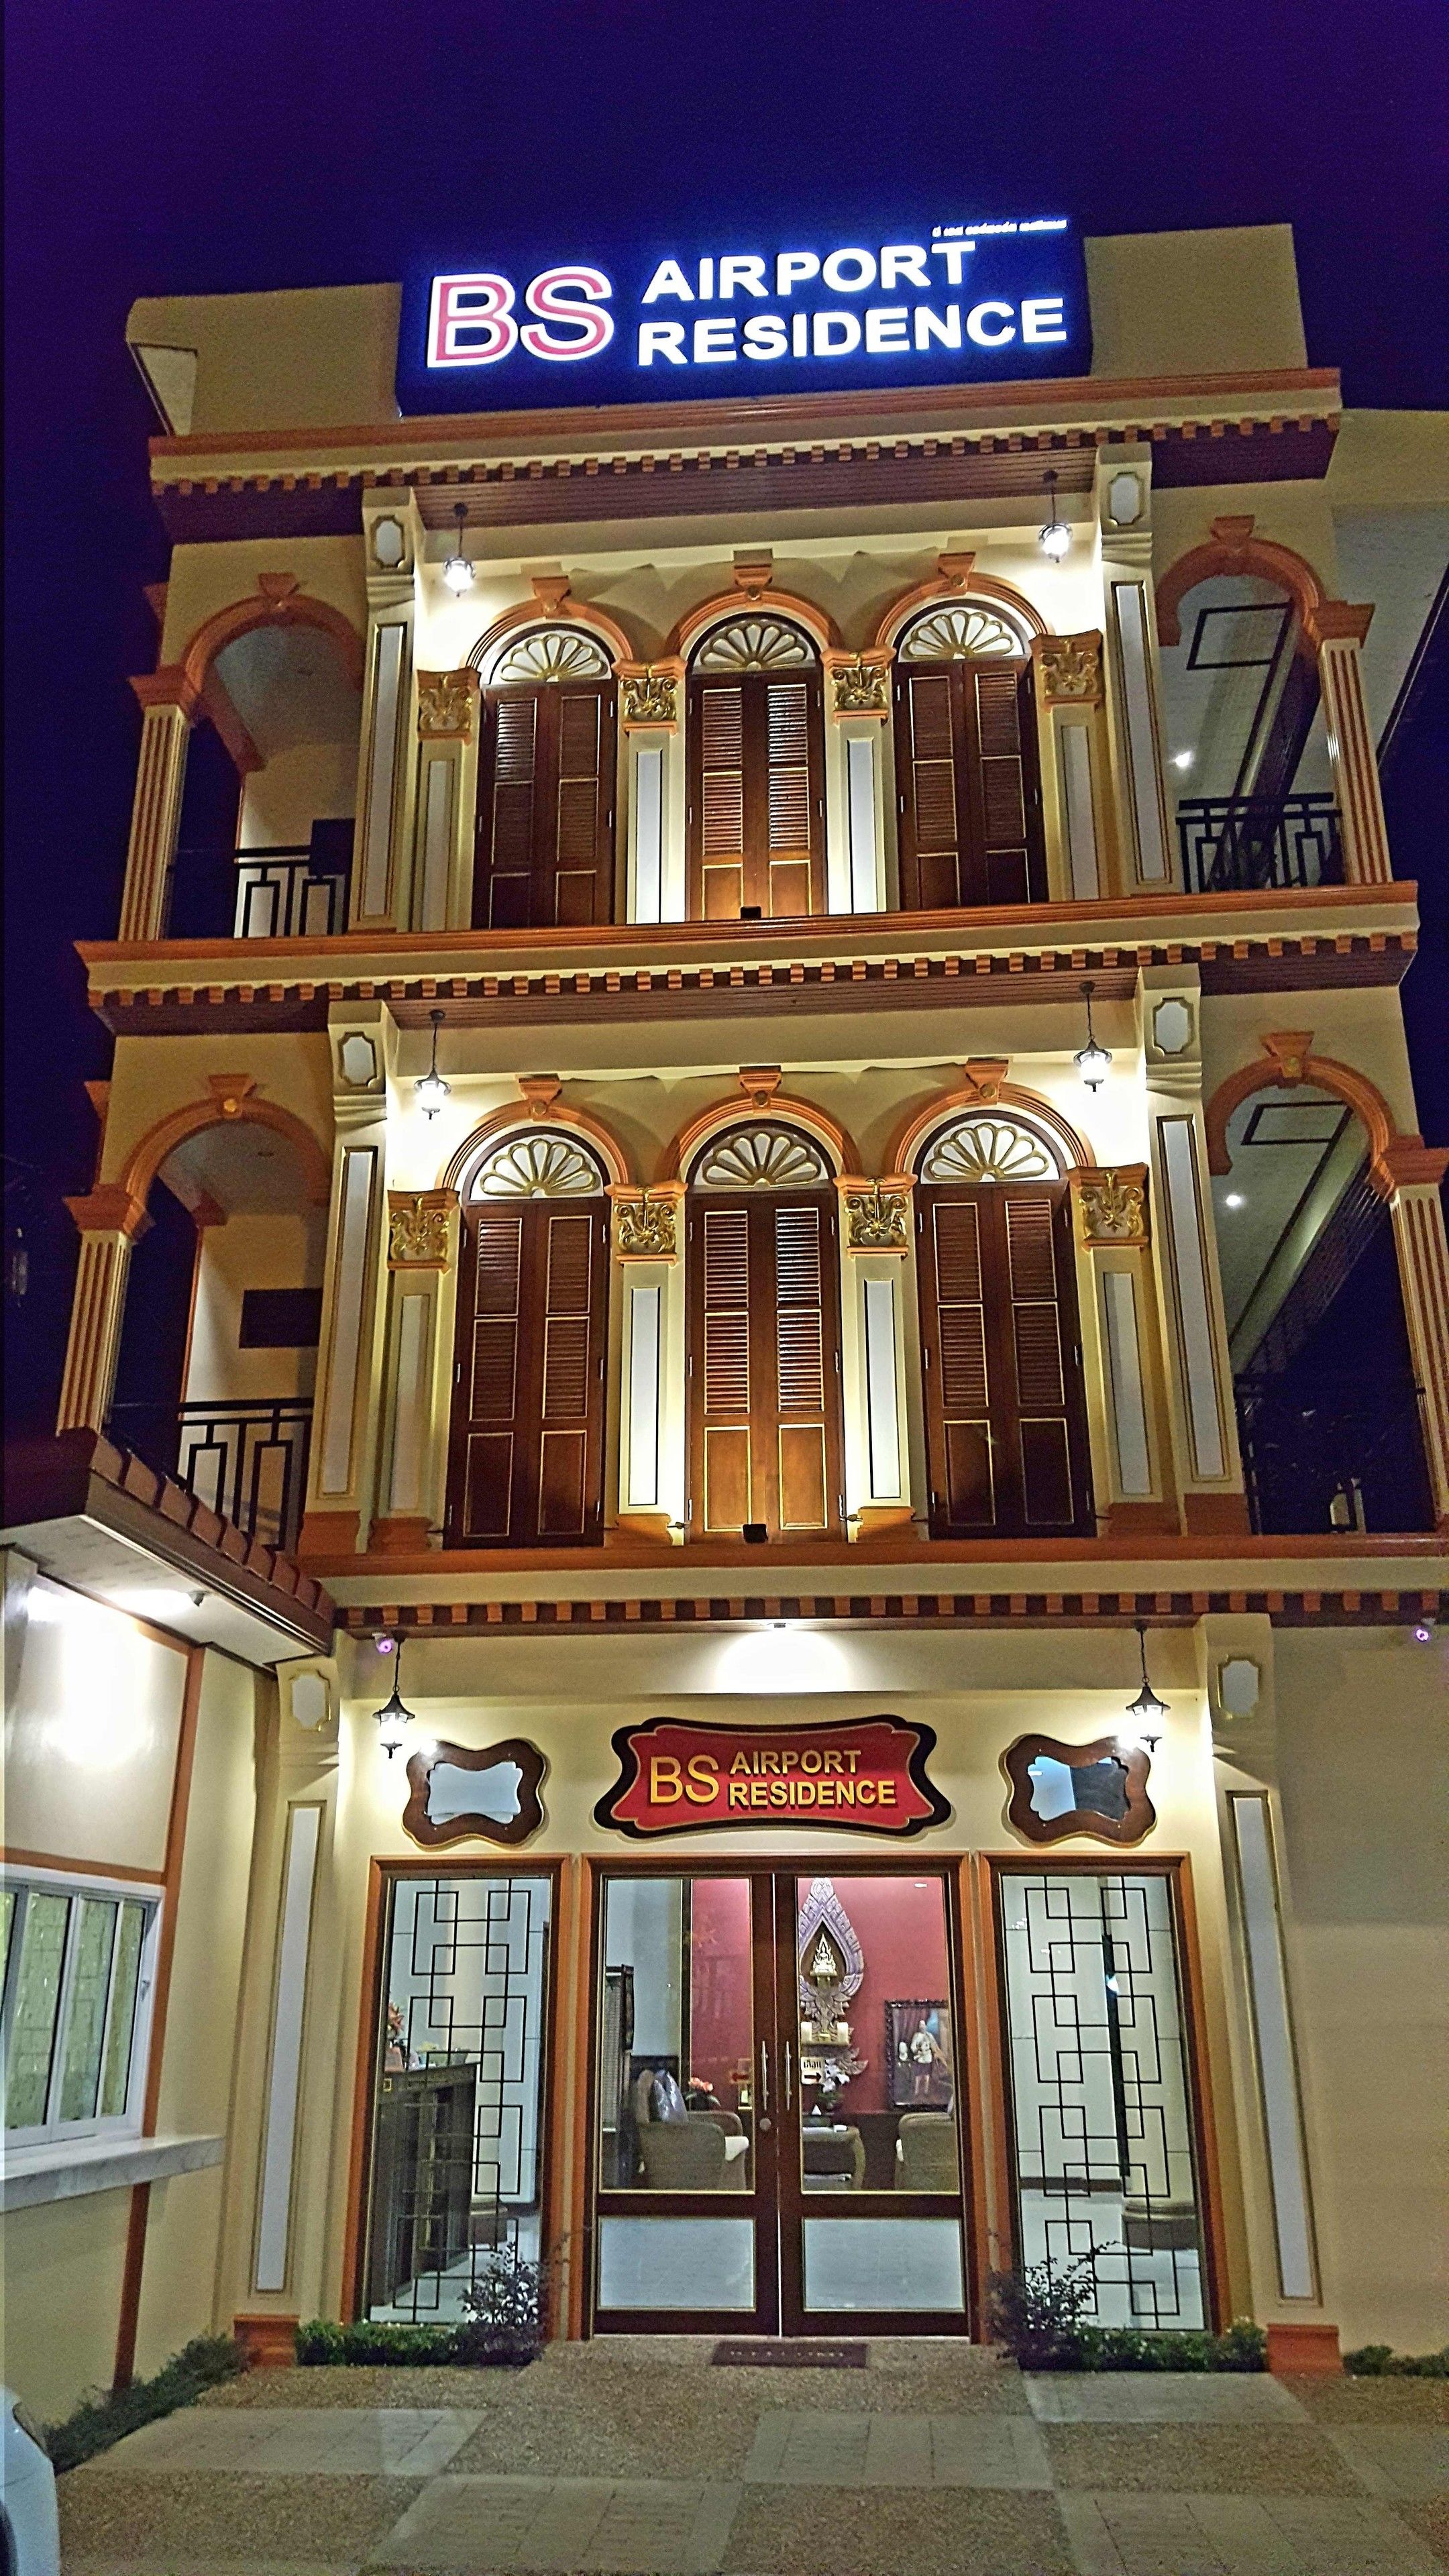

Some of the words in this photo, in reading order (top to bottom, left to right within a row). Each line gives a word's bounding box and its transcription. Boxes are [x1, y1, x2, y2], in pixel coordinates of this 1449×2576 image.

[641, 240, 976, 304] AIRPORT
[427, 266, 615, 369] BS
[639, 297, 1068, 366] RESIDENCE
[650, 1755, 720, 1803] BS
[730, 1750, 861, 1774] AIRPORT
[729, 1780, 896, 1806] RESIDENCE
